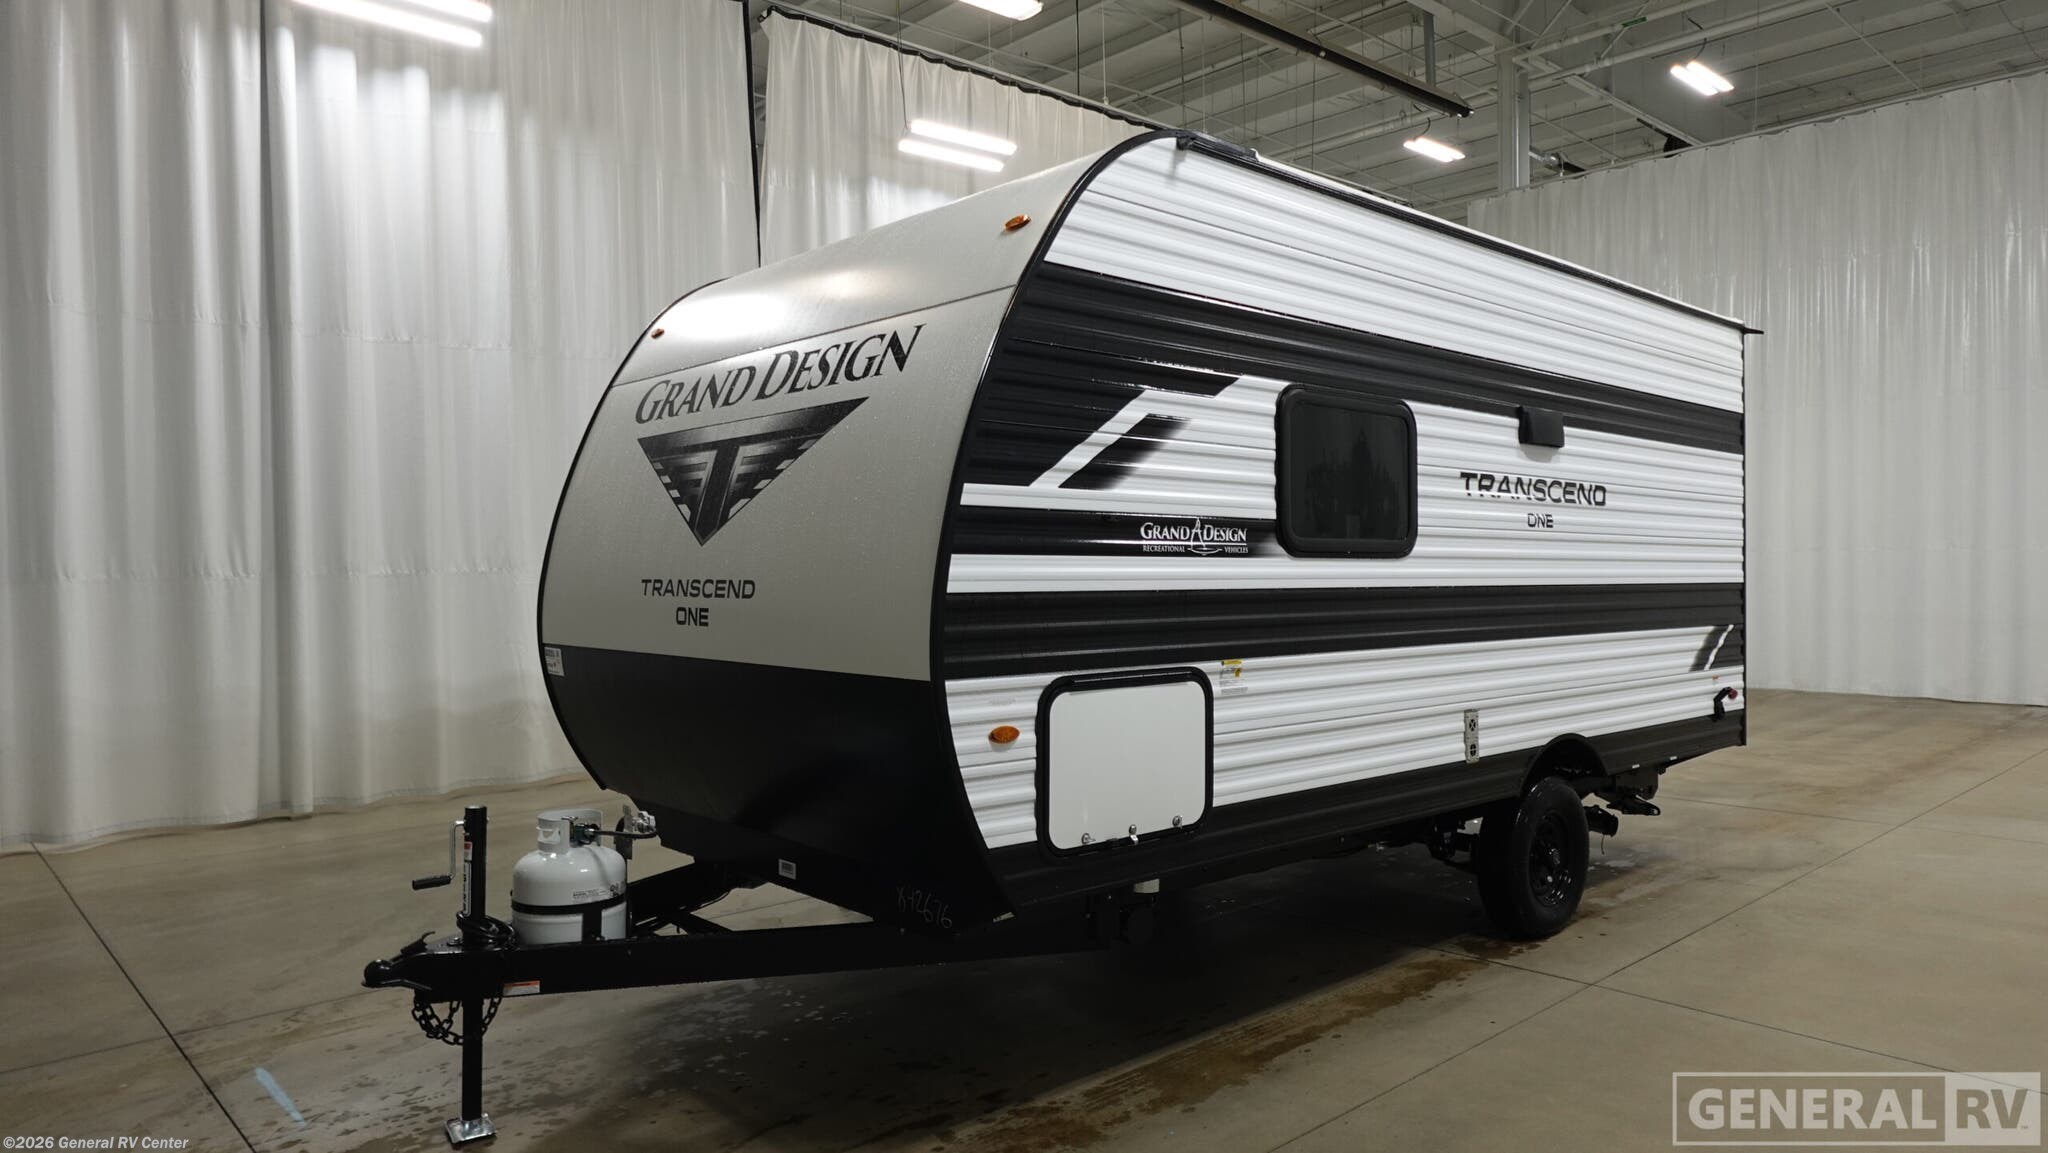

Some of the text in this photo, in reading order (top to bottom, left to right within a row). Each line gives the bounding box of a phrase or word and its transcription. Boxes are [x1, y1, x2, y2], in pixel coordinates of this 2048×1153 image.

[635, 323, 927, 424] GRAND DESIGN
[1459, 471, 1607, 506] TRANSCEND
[1527, 512, 1554, 528] ONE
[1140, 521, 1248, 542] GRAND DESIGN
[1142, 544, 1249, 554] RECREATIONAL VEHICLES
[641, 578, 756, 599] TRANSCEND
[675, 606, 709, 627] ONE
